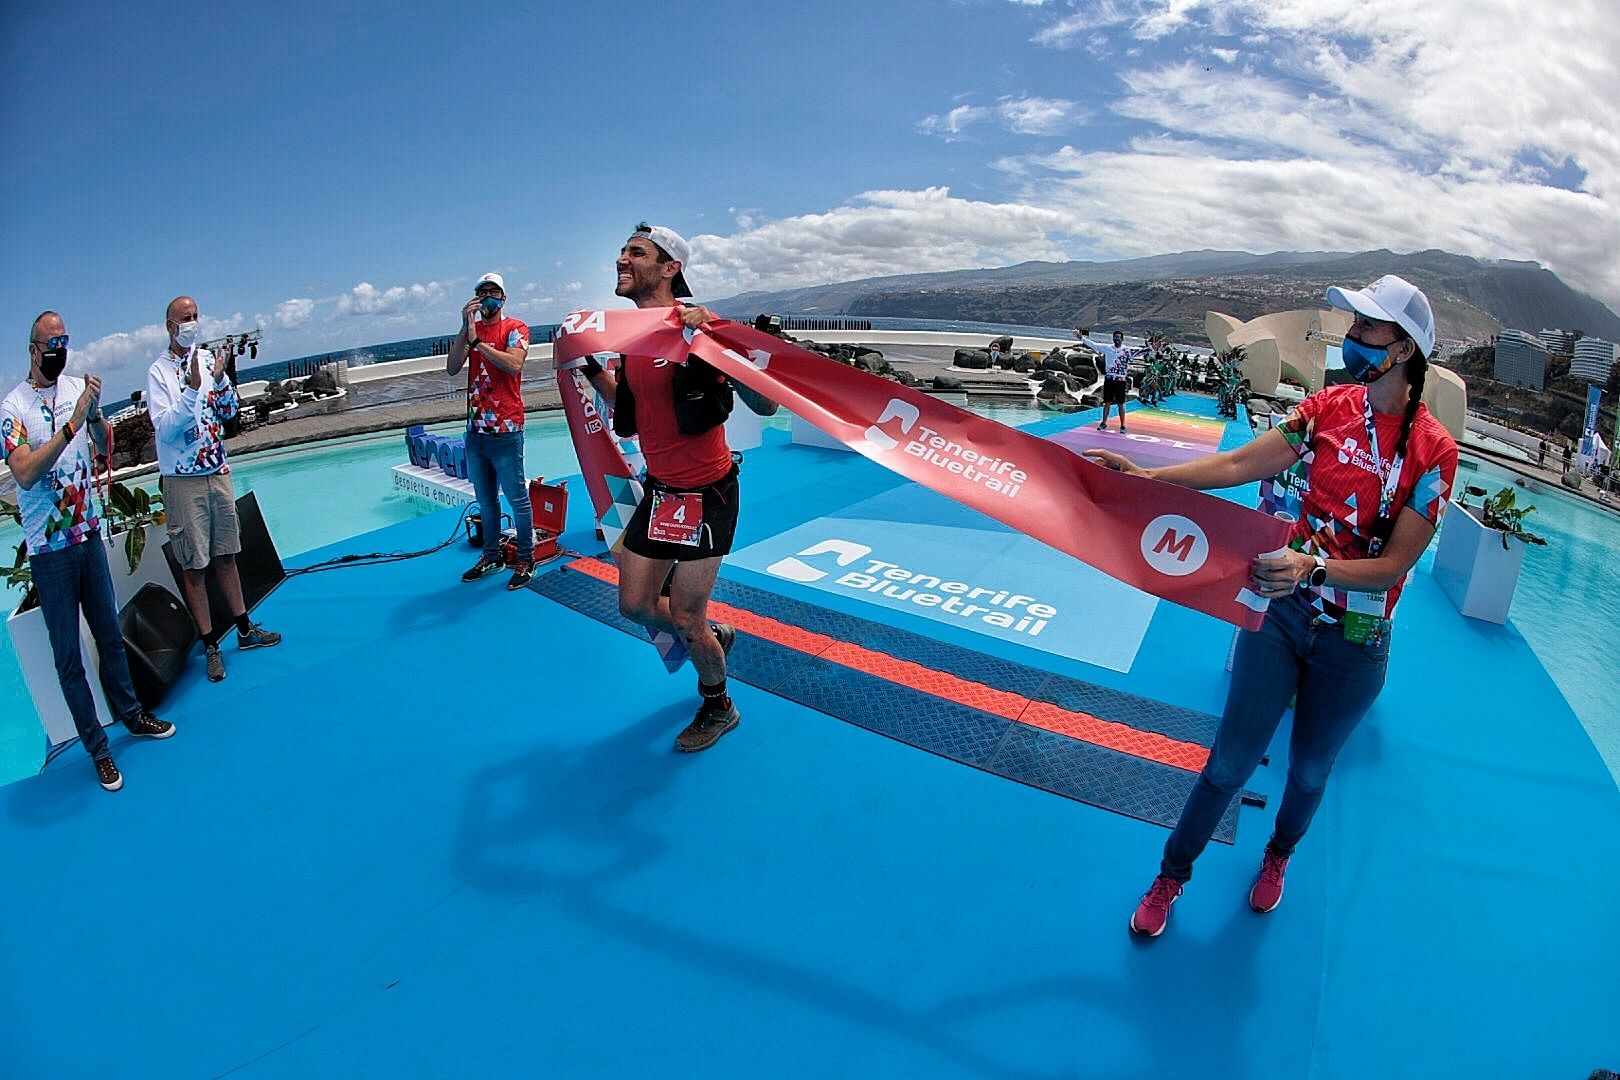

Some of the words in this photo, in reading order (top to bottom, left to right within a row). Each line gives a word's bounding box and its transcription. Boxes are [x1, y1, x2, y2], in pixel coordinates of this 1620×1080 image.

[394, 471, 430, 497] despierta
[904, 440, 1022, 498] Bluetrail
[918, 426, 1028, 484] Tenerife
[673, 505, 686, 524] 4
[1152, 528, 1196, 562] M
[834, 572, 1049, 636] Bluetrail
[861, 560, 1058, 619] Tenerife
